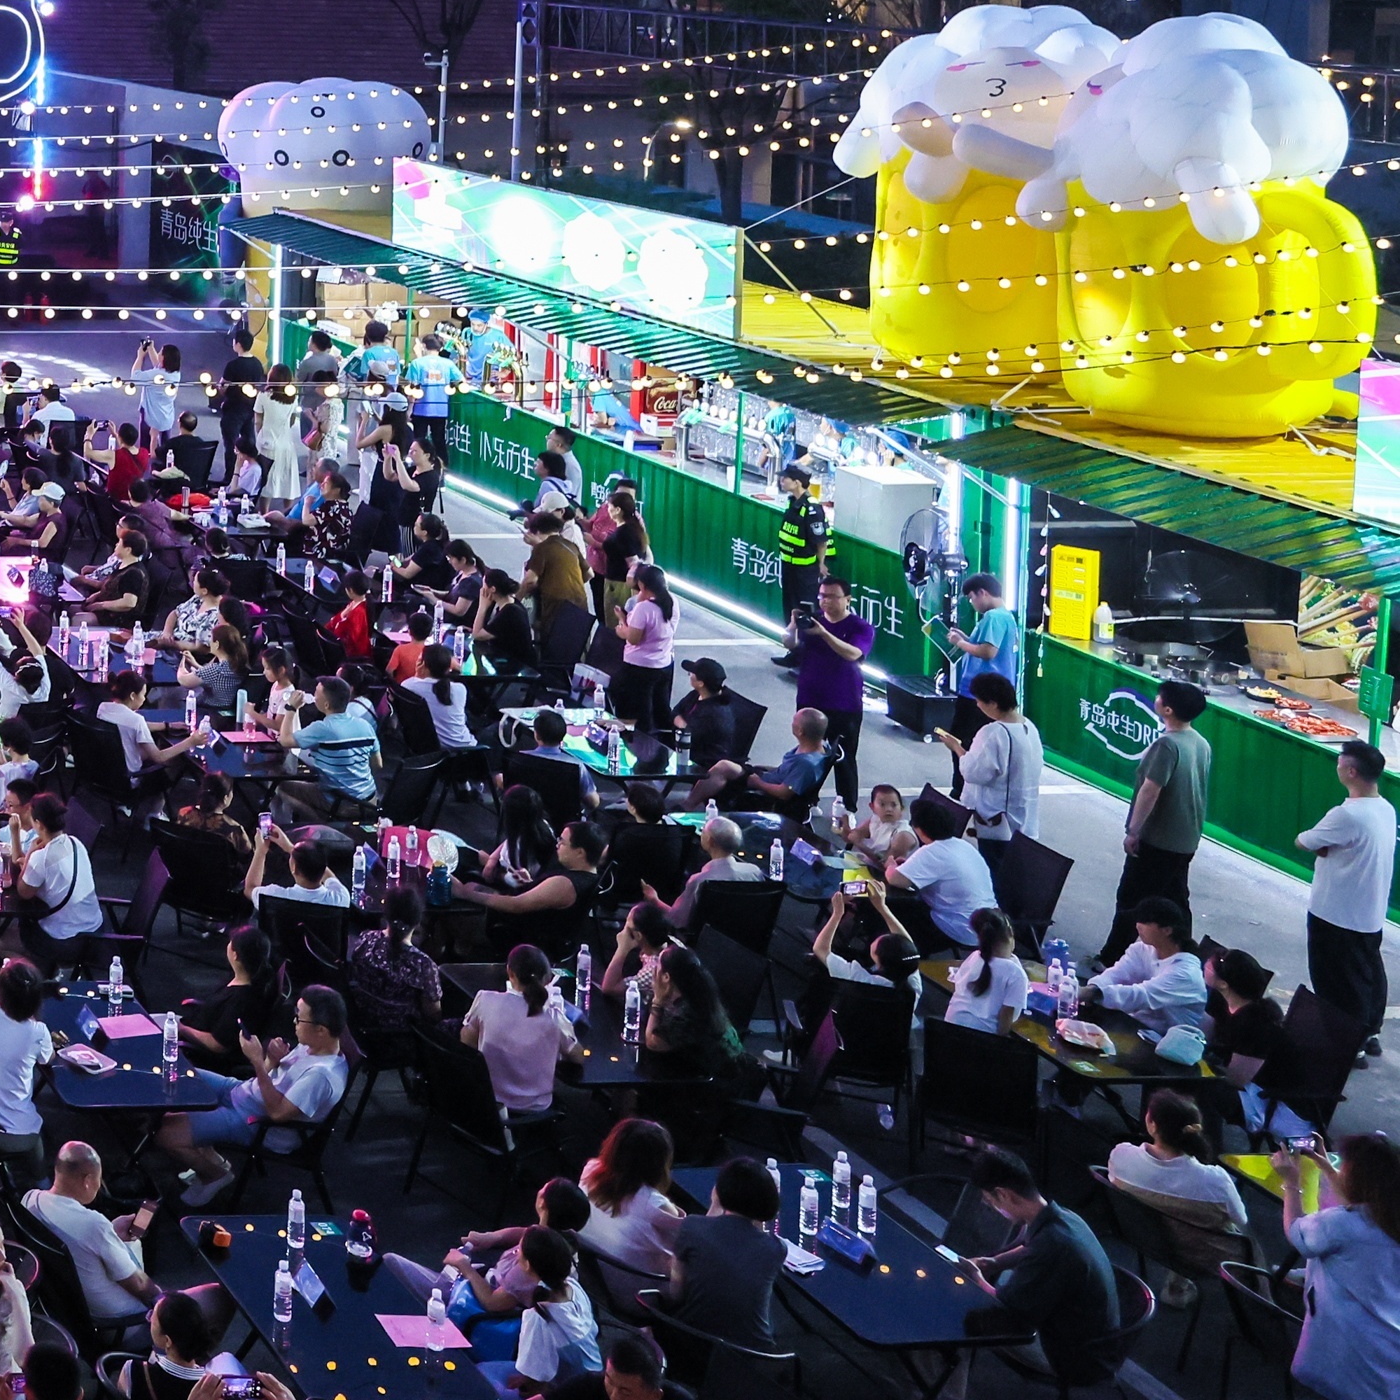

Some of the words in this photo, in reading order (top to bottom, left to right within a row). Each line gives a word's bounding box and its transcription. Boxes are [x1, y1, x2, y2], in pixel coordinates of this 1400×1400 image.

[160, 208, 218, 253] 青岛纯生
[654, 396, 677, 413] Coca
